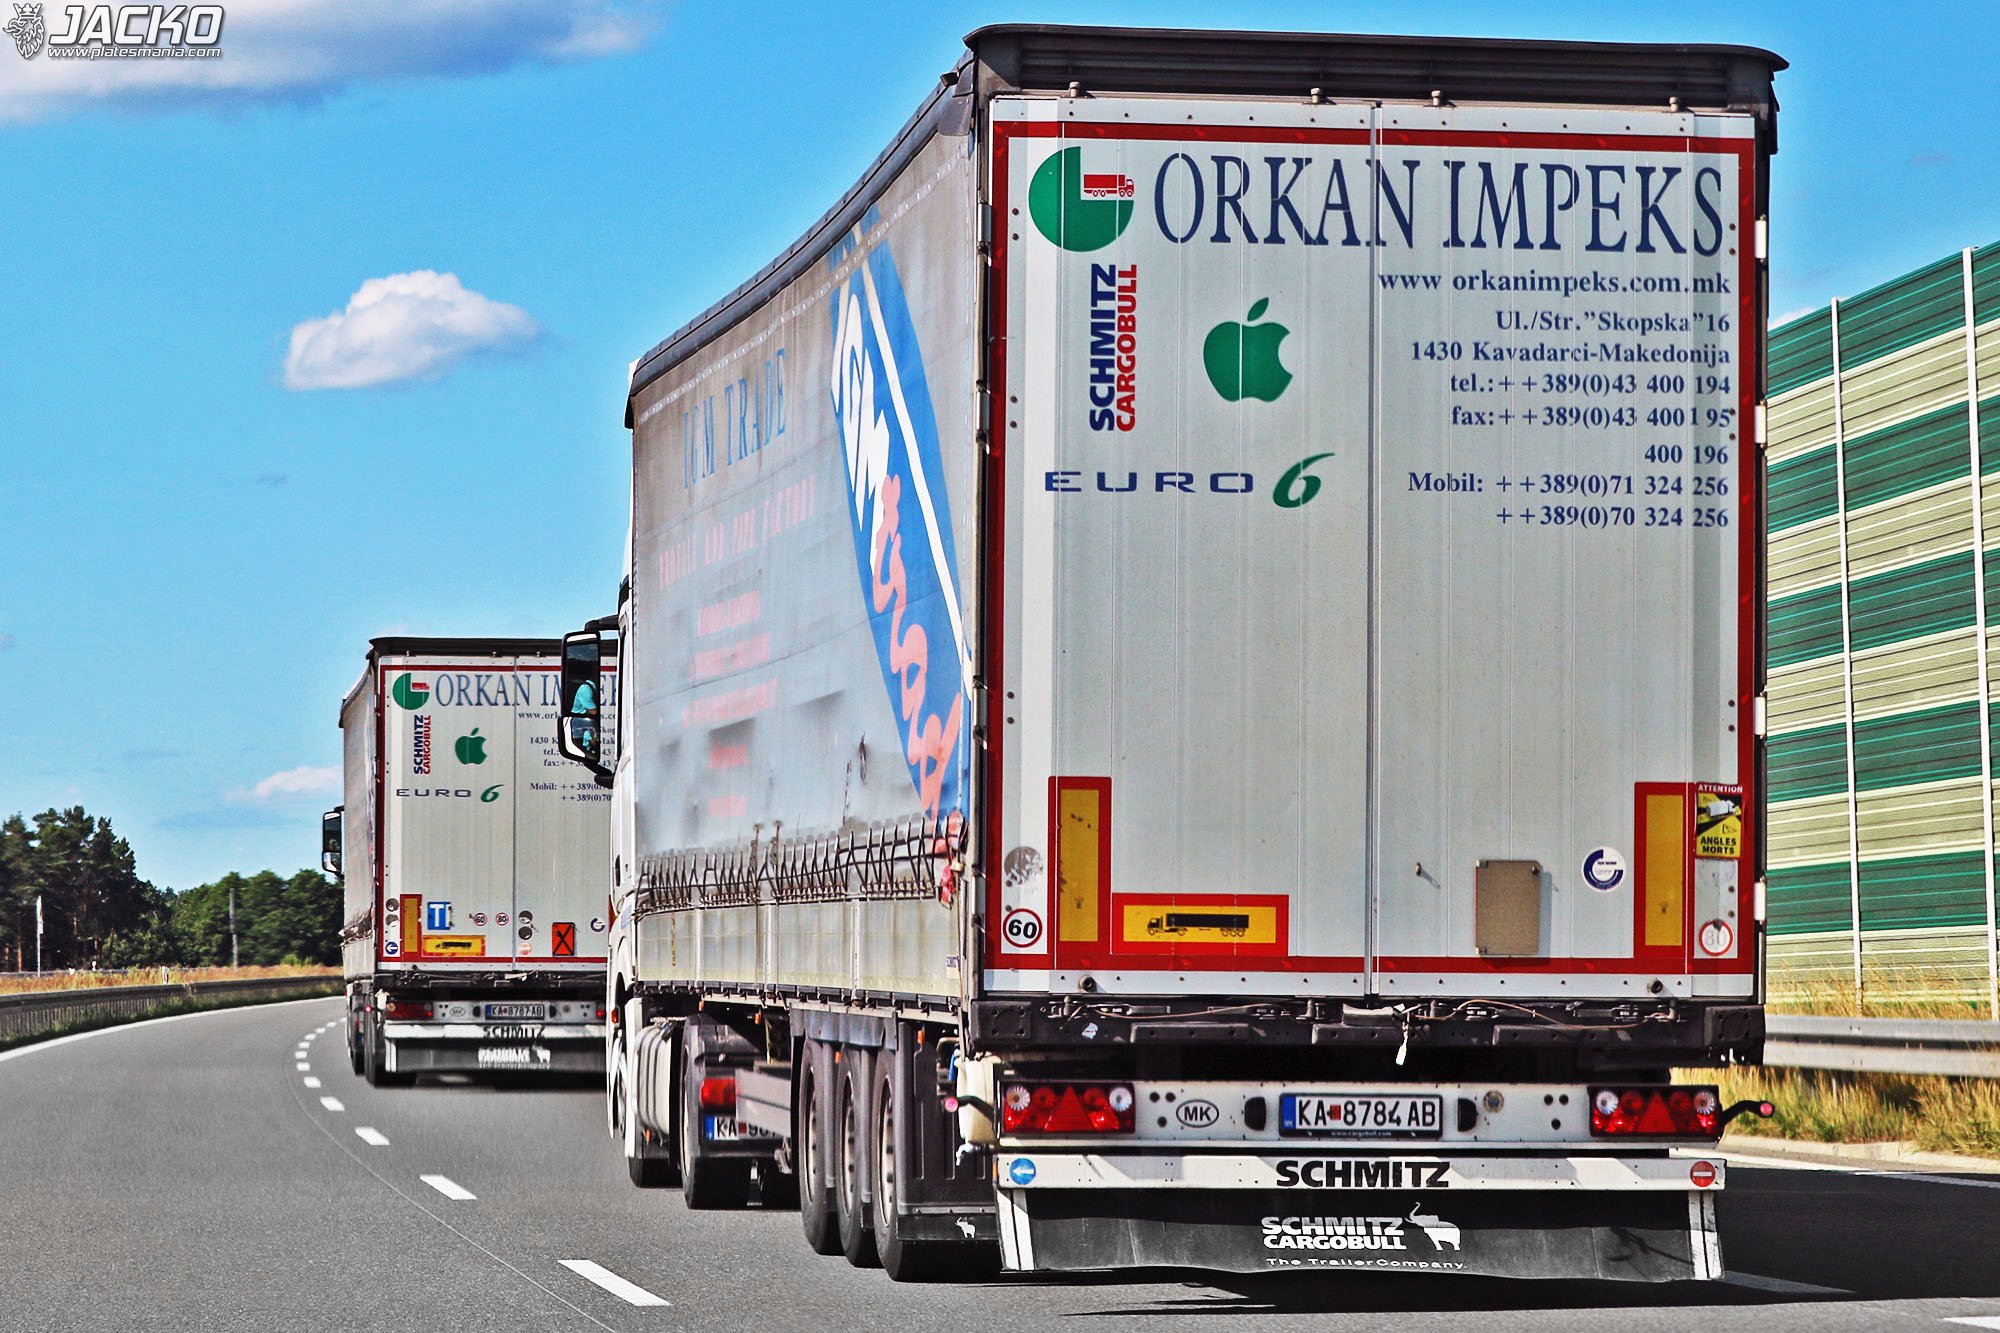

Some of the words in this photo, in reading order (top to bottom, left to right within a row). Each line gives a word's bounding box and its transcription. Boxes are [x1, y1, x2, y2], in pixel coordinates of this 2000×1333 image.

[1154, 152, 1421, 249] ORKAN
[1442, 159, 1723, 258] IMPEKS
[1089, 263, 1116, 431] SCHMITZ
[1116, 264, 1137, 432] CARGOBULL
[1411, 341, 1463, 361] 1430
[1473, 342, 1731, 368] Kavadarci-Makedonija
[1647, 375, 1685, 394] 400
[1695, 375, 1731, 395] 194
[725, 348, 786, 466] TRADE
[1647, 406, 1685, 426] 400
[1645, 445, 1683, 464] 400
[1693, 445, 1729, 465] 196
[1045, 471, 1254, 493] EURO
[1272, 452, 1336, 508] 6
[1408, 472, 1483, 493] Mobil:
[1645, 475, 1683, 496] 324
[1692, 475, 1729, 496] 256
[1645, 507, 1683, 527] 324
[1692, 507, 1729, 528] 256
[435, 674, 532, 707] ORKAN
[413, 715, 424, 774] SCHMITZ
[423, 715, 432, 774] CARGOBULL
[396, 789, 471, 797] EURO
[481, 784, 504, 803] 6
[1698, 784, 1743, 793] ATTENTION
[1701, 836, 1736, 846] ANGLES
[1702, 846, 1735, 855] MORTS
[1008, 919, 1037, 939] 60
[483, 1026, 545, 1038] SCHMITZ
[1184, 1106, 1211, 1121] MK
[1276, 1160, 1450, 1188] SCHMITZ
[1261, 1216, 1405, 1236] SCHMITZ
[1263, 1235, 1407, 1250] CARGOBULL
[1266, 1258, 1301, 1266] The
